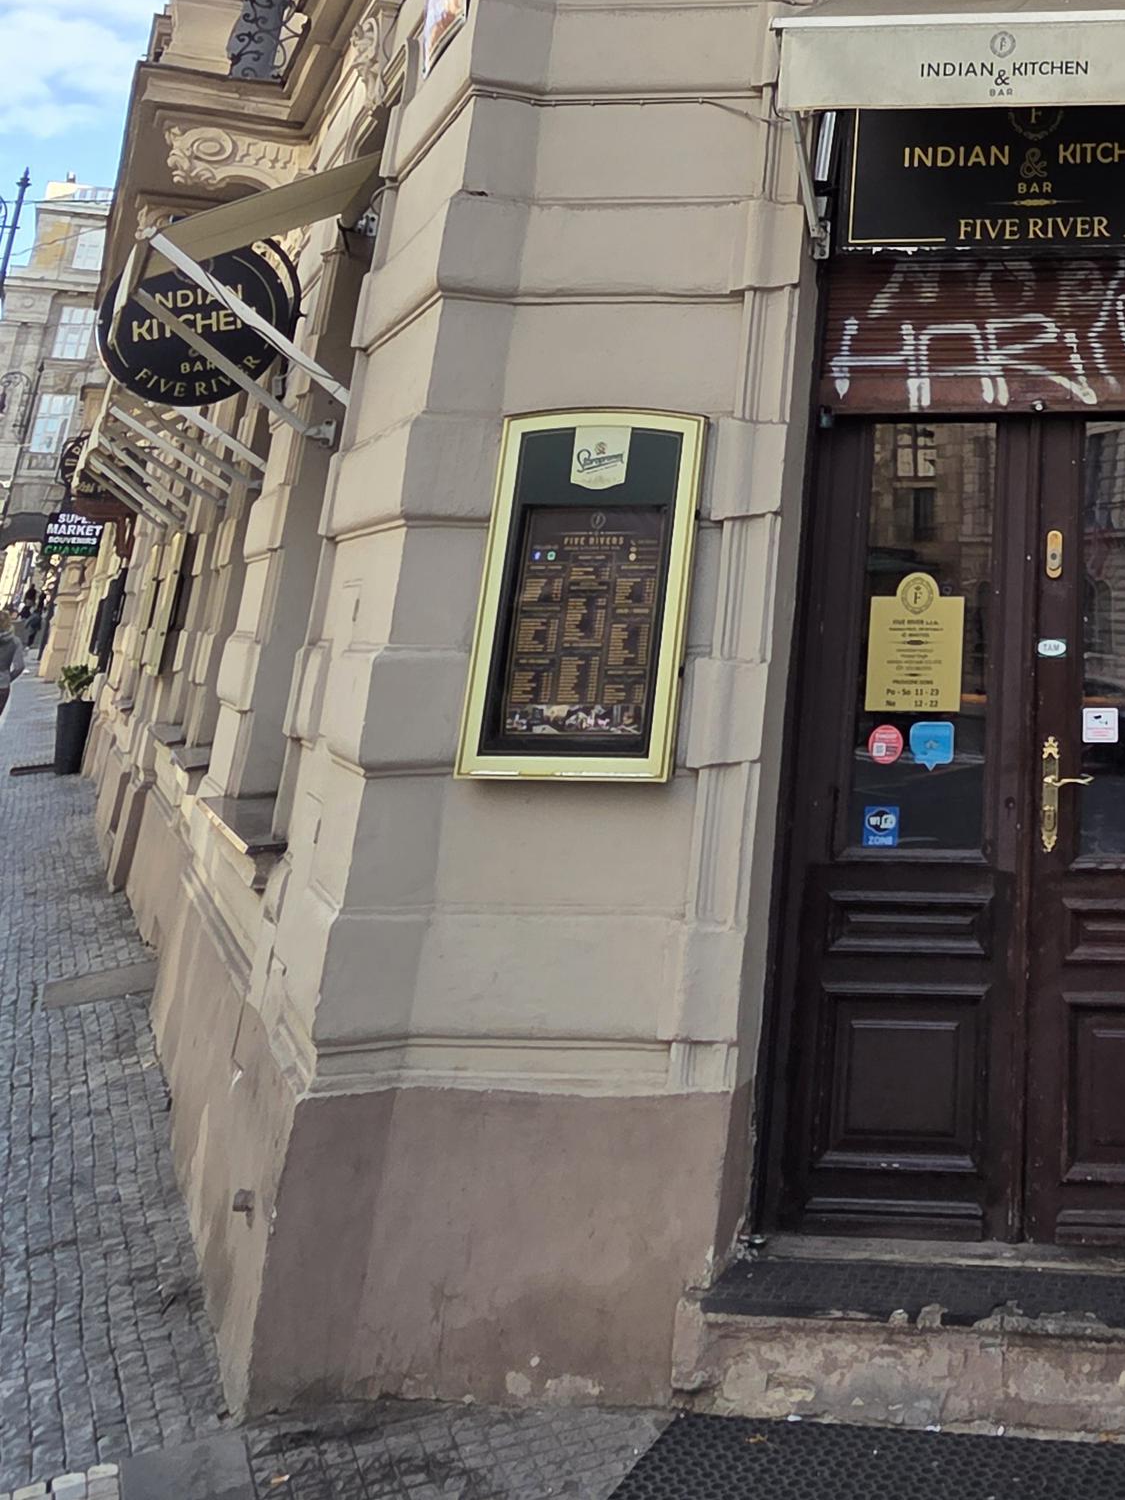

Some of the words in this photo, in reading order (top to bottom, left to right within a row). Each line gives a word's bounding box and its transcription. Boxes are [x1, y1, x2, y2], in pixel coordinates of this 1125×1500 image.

[920, 62, 994, 77] INDIAN
[994, 69, 1010, 86] &
[1012, 61, 1089, 76] KITCHEN
[989, 88, 1013, 97] BAR
[903, 145, 1010, 168] INDIAN
[1020, 147, 1048, 179] &
[1017, 181, 1053, 194] BAR
[958, 218, 1020, 240] FIVE
[1028, 215, 1111, 239] RIVER
[154, 284, 242, 309] NDIN
[131, 306, 257, 342] KIHE
[134, 368, 188, 397] FIVE
[195, 355, 261, 396] RIVR
[180, 361, 217, 374] BAR
[46, 523, 104, 537] MARKET
[57, 513, 97, 525] SUPE
